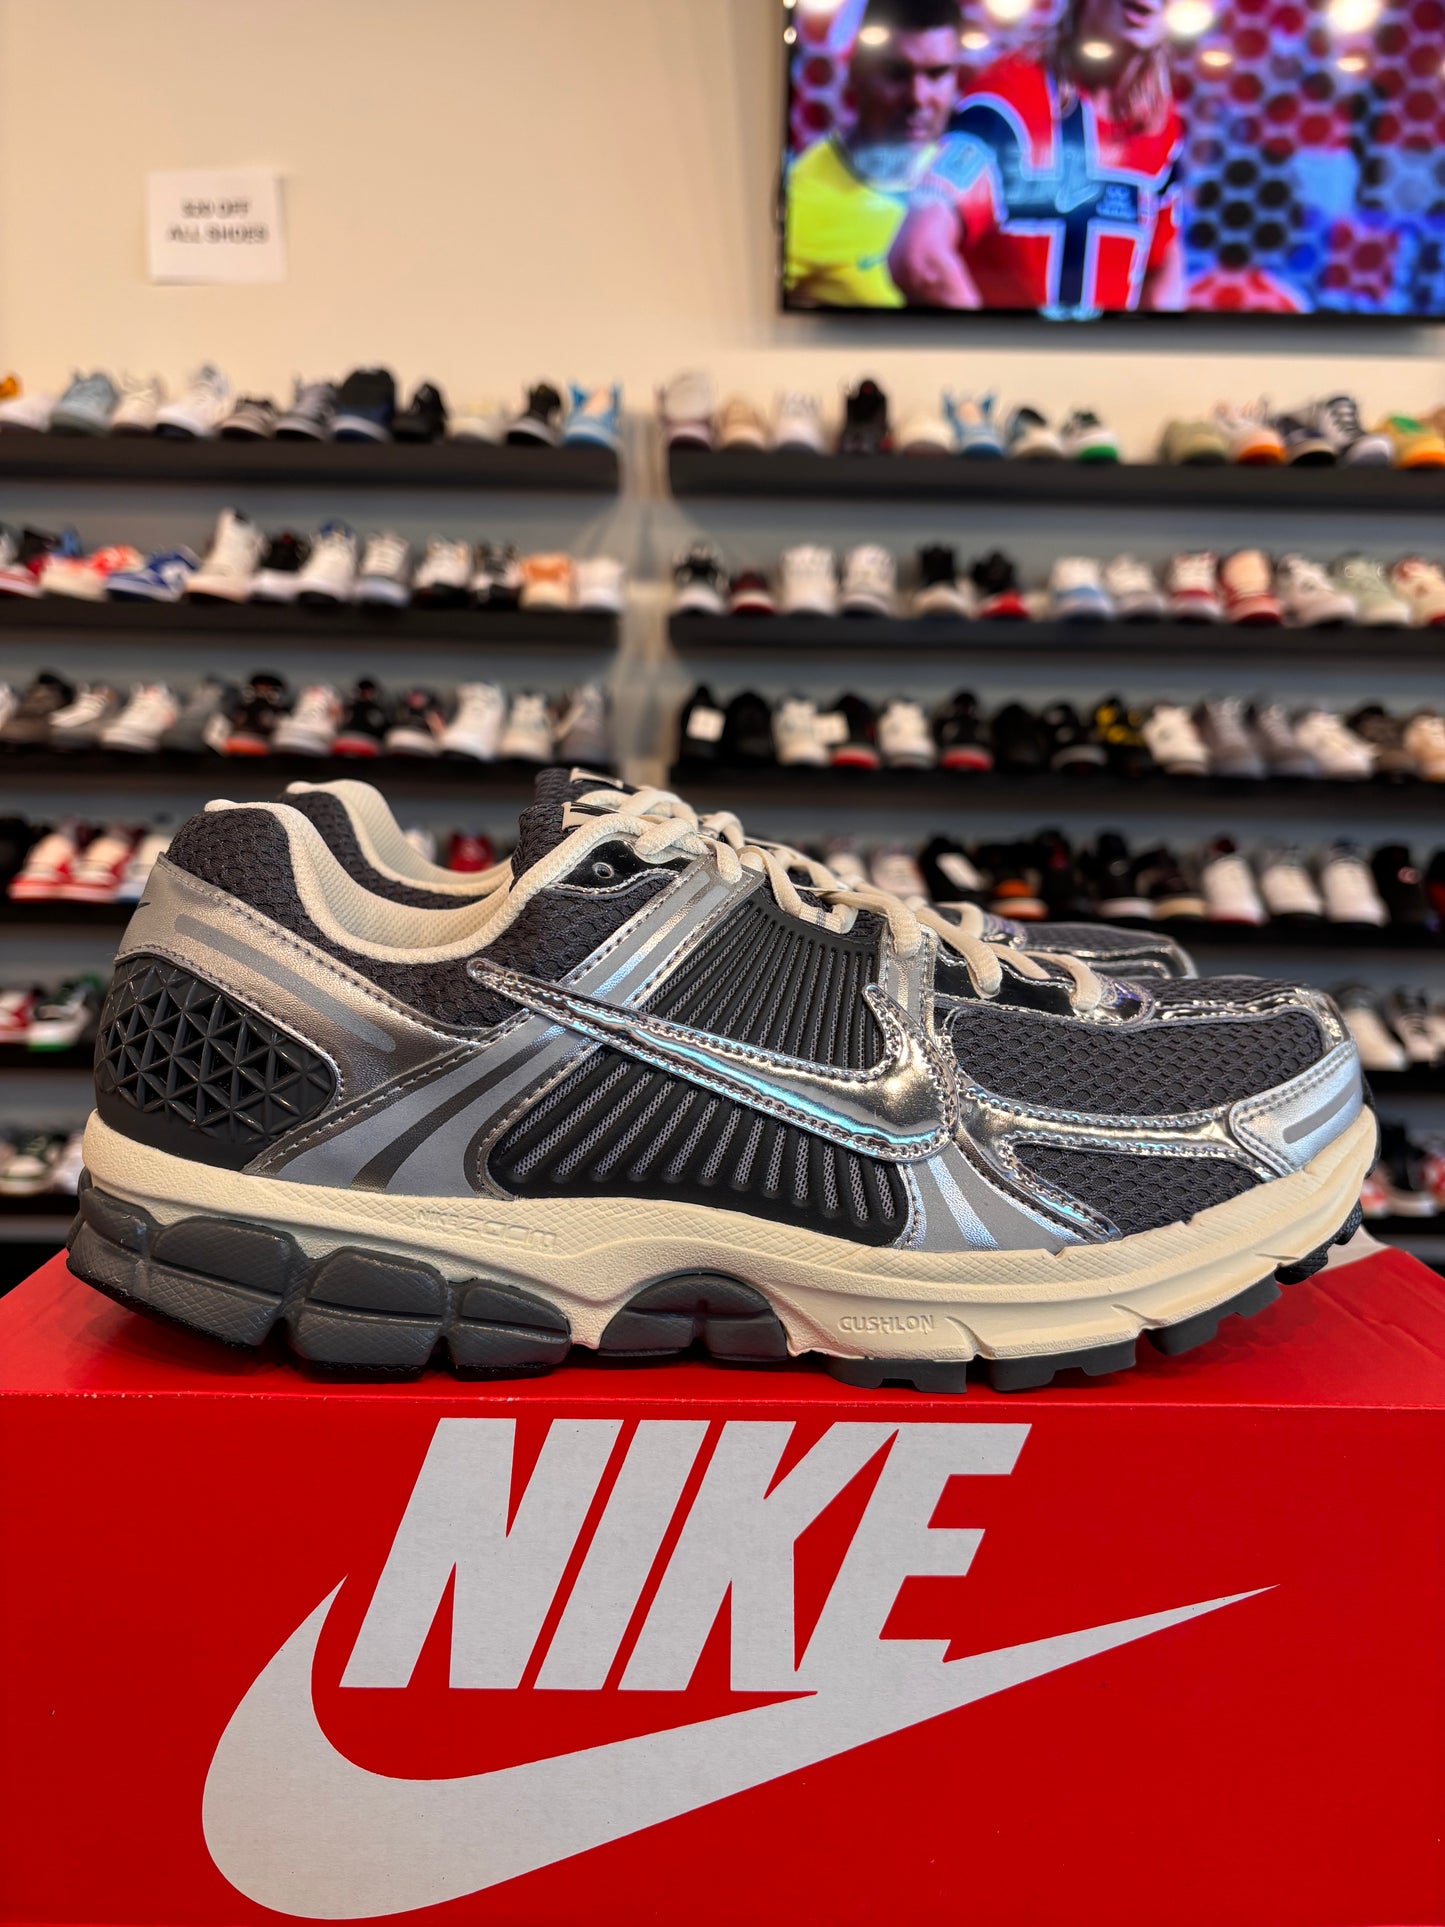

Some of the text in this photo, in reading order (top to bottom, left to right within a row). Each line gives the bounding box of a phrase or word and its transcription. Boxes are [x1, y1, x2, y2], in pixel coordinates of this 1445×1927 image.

[168, 221, 269, 243] ALL SHOES
[416, 1209, 557, 1247] NIKE ZOOM
[838, 1314, 936, 1333] CUSHLON
[339, 1417, 1032, 1692] NIKE
